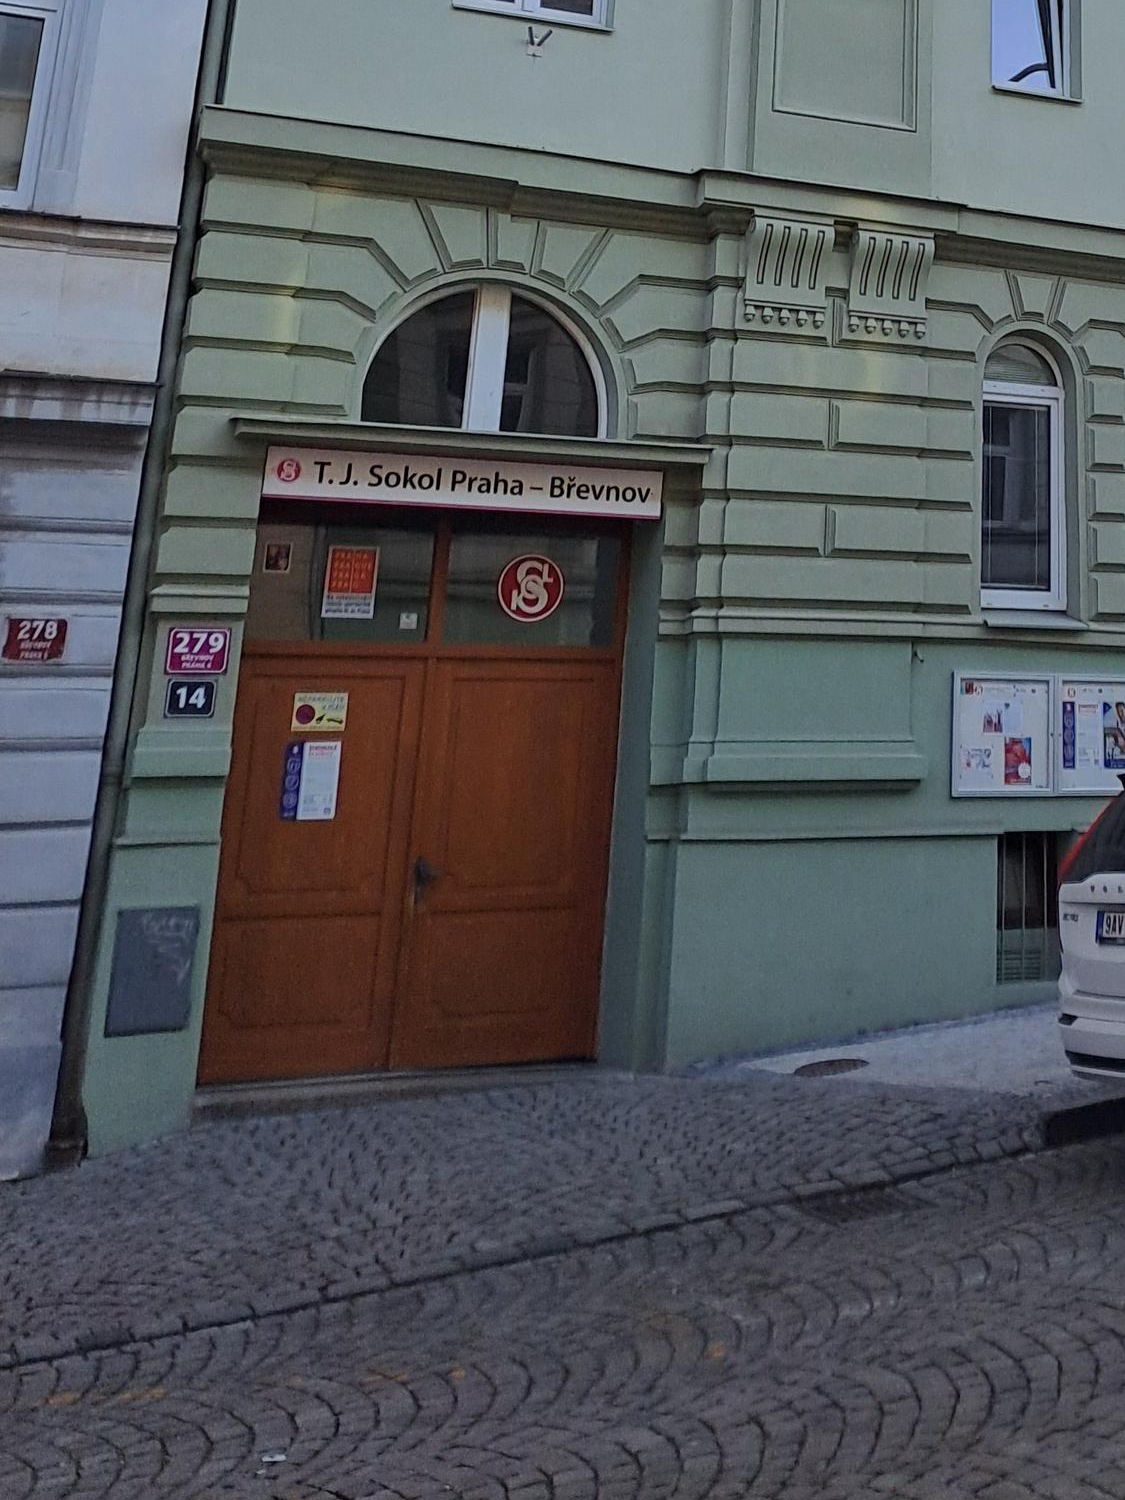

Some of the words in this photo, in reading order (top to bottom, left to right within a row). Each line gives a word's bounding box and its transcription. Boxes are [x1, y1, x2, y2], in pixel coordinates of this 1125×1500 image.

[367, 464, 443, 491] Sokol
[450, 470, 524, 496] Praha
[550, 476, 651, 503] Břevnov
[17, 620, 58, 640] 278
[173, 632, 225, 654] 279
[176, 685, 206, 709] 14
[1105, 915, 1124, 935] 9AV
